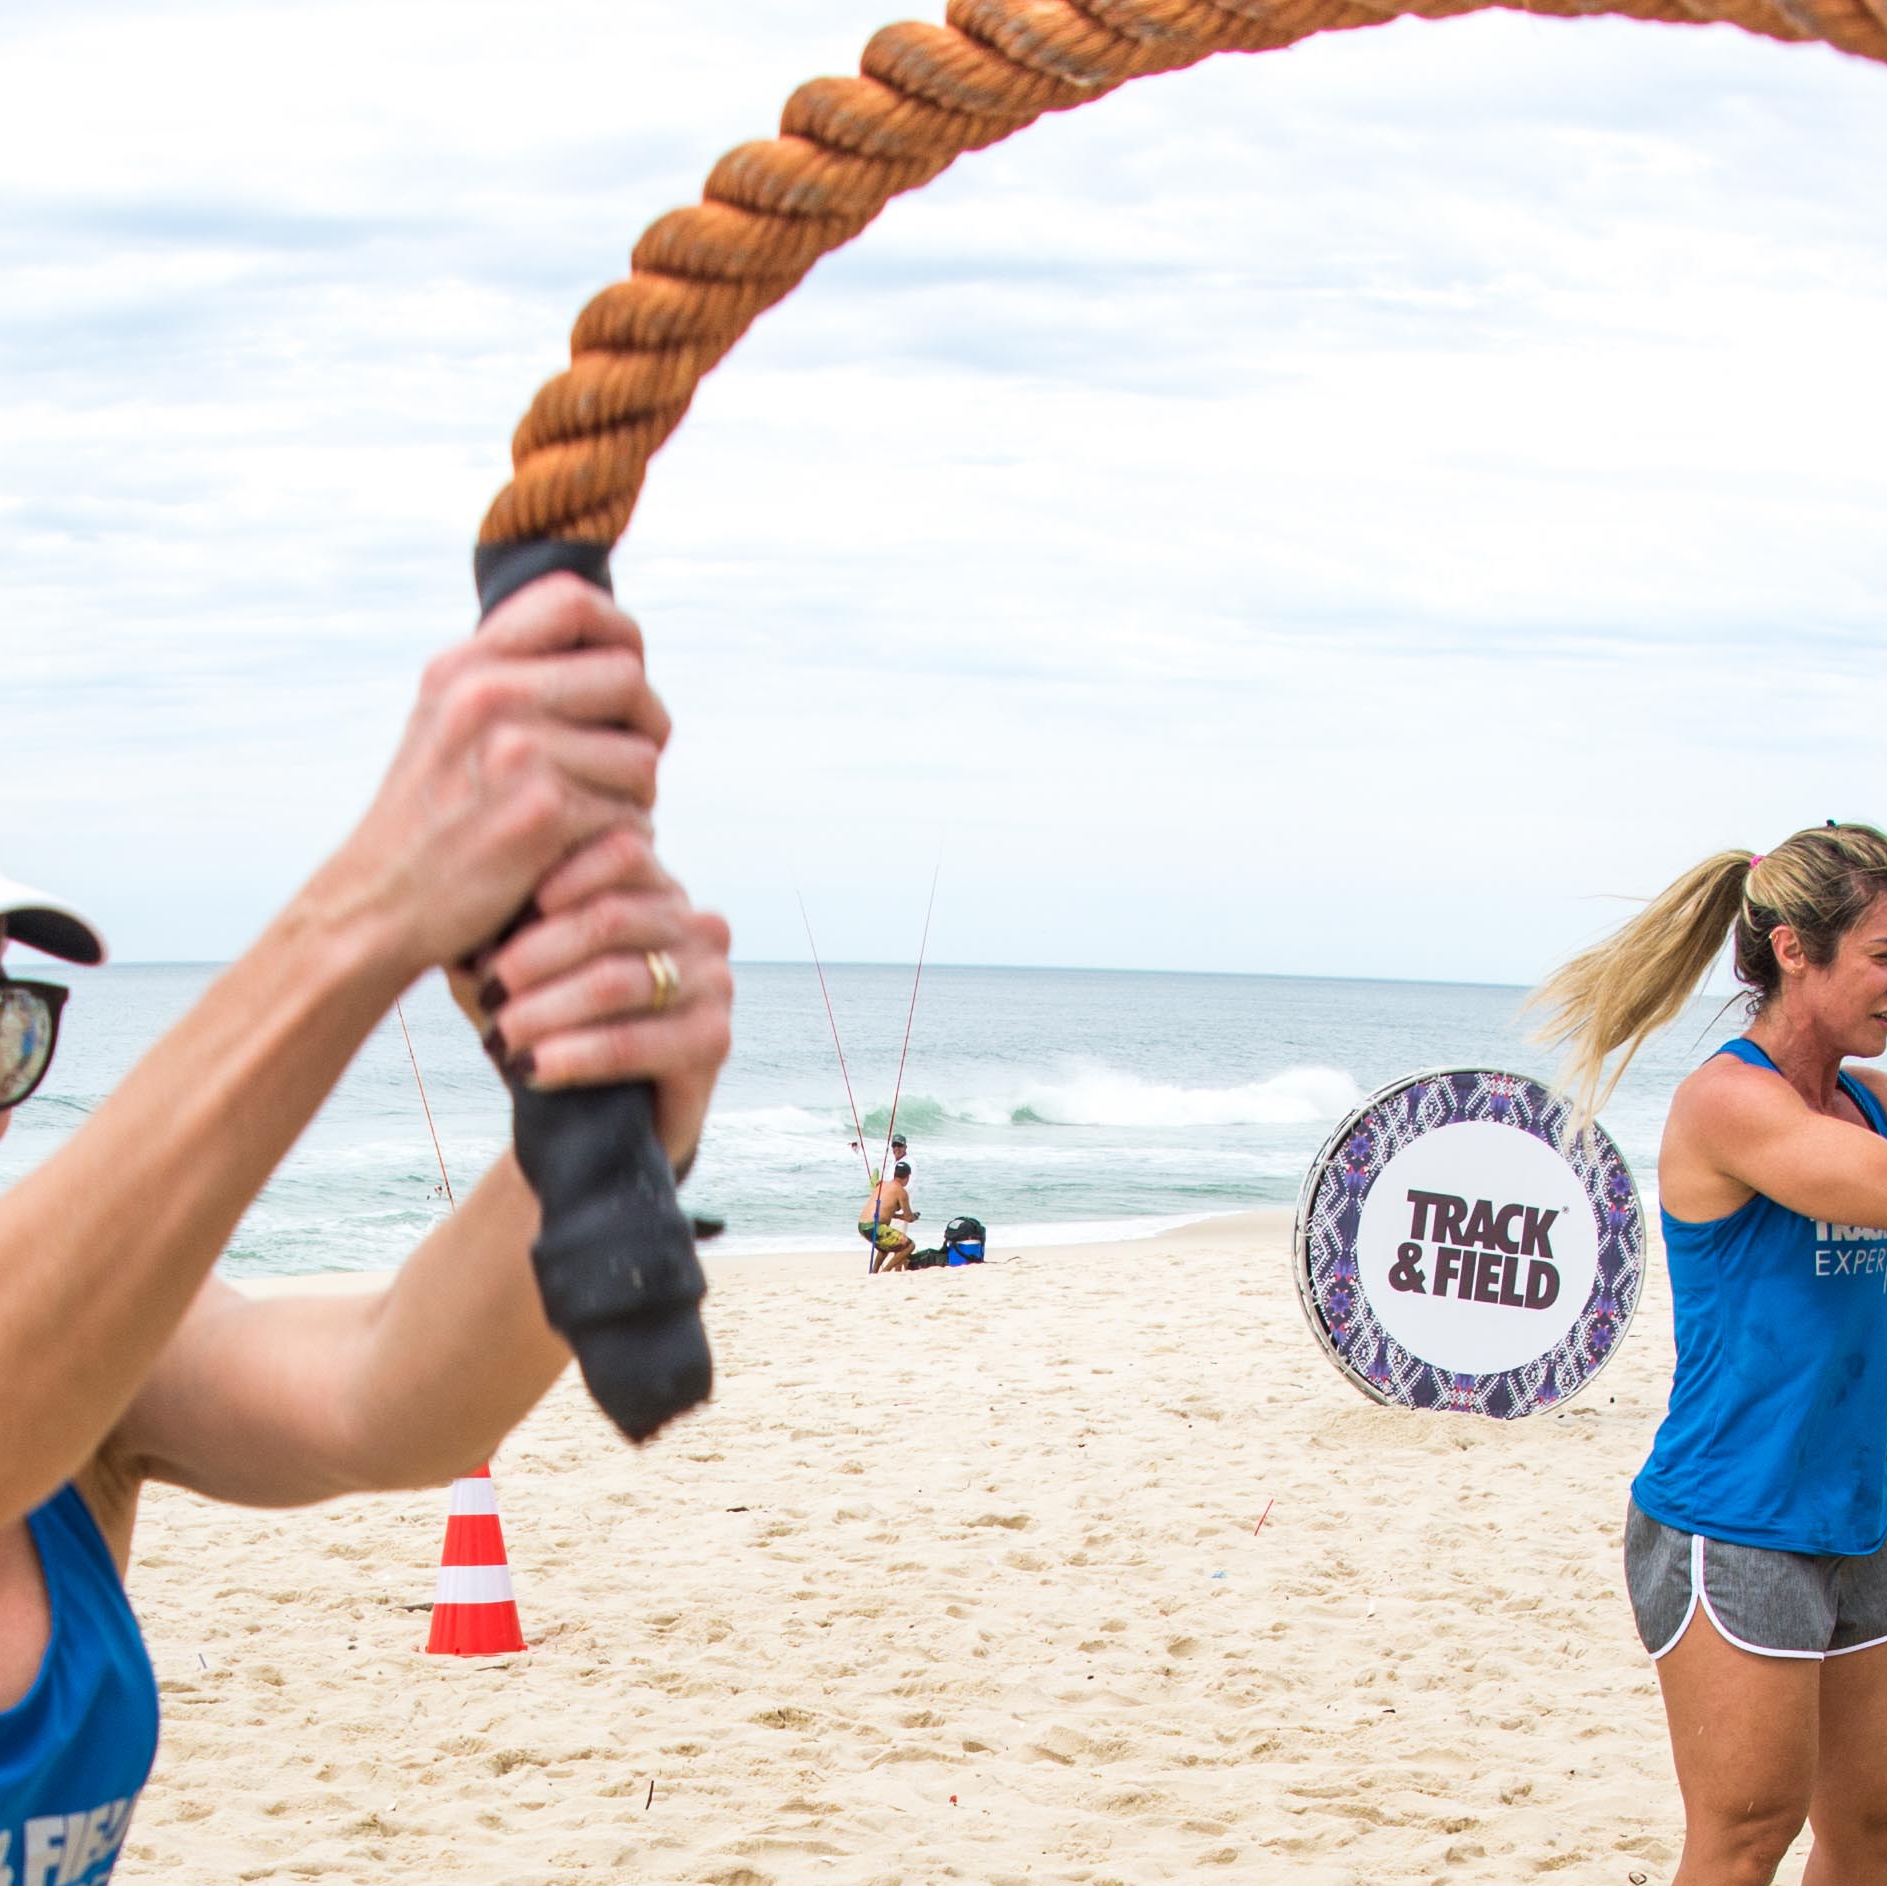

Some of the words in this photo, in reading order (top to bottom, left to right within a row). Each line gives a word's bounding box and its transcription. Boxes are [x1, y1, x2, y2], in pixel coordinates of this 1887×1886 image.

[1406, 1189, 1560, 1260] TRACK
[1388, 1242, 1427, 1295] &
[1432, 1246, 1561, 1311] FIELD
